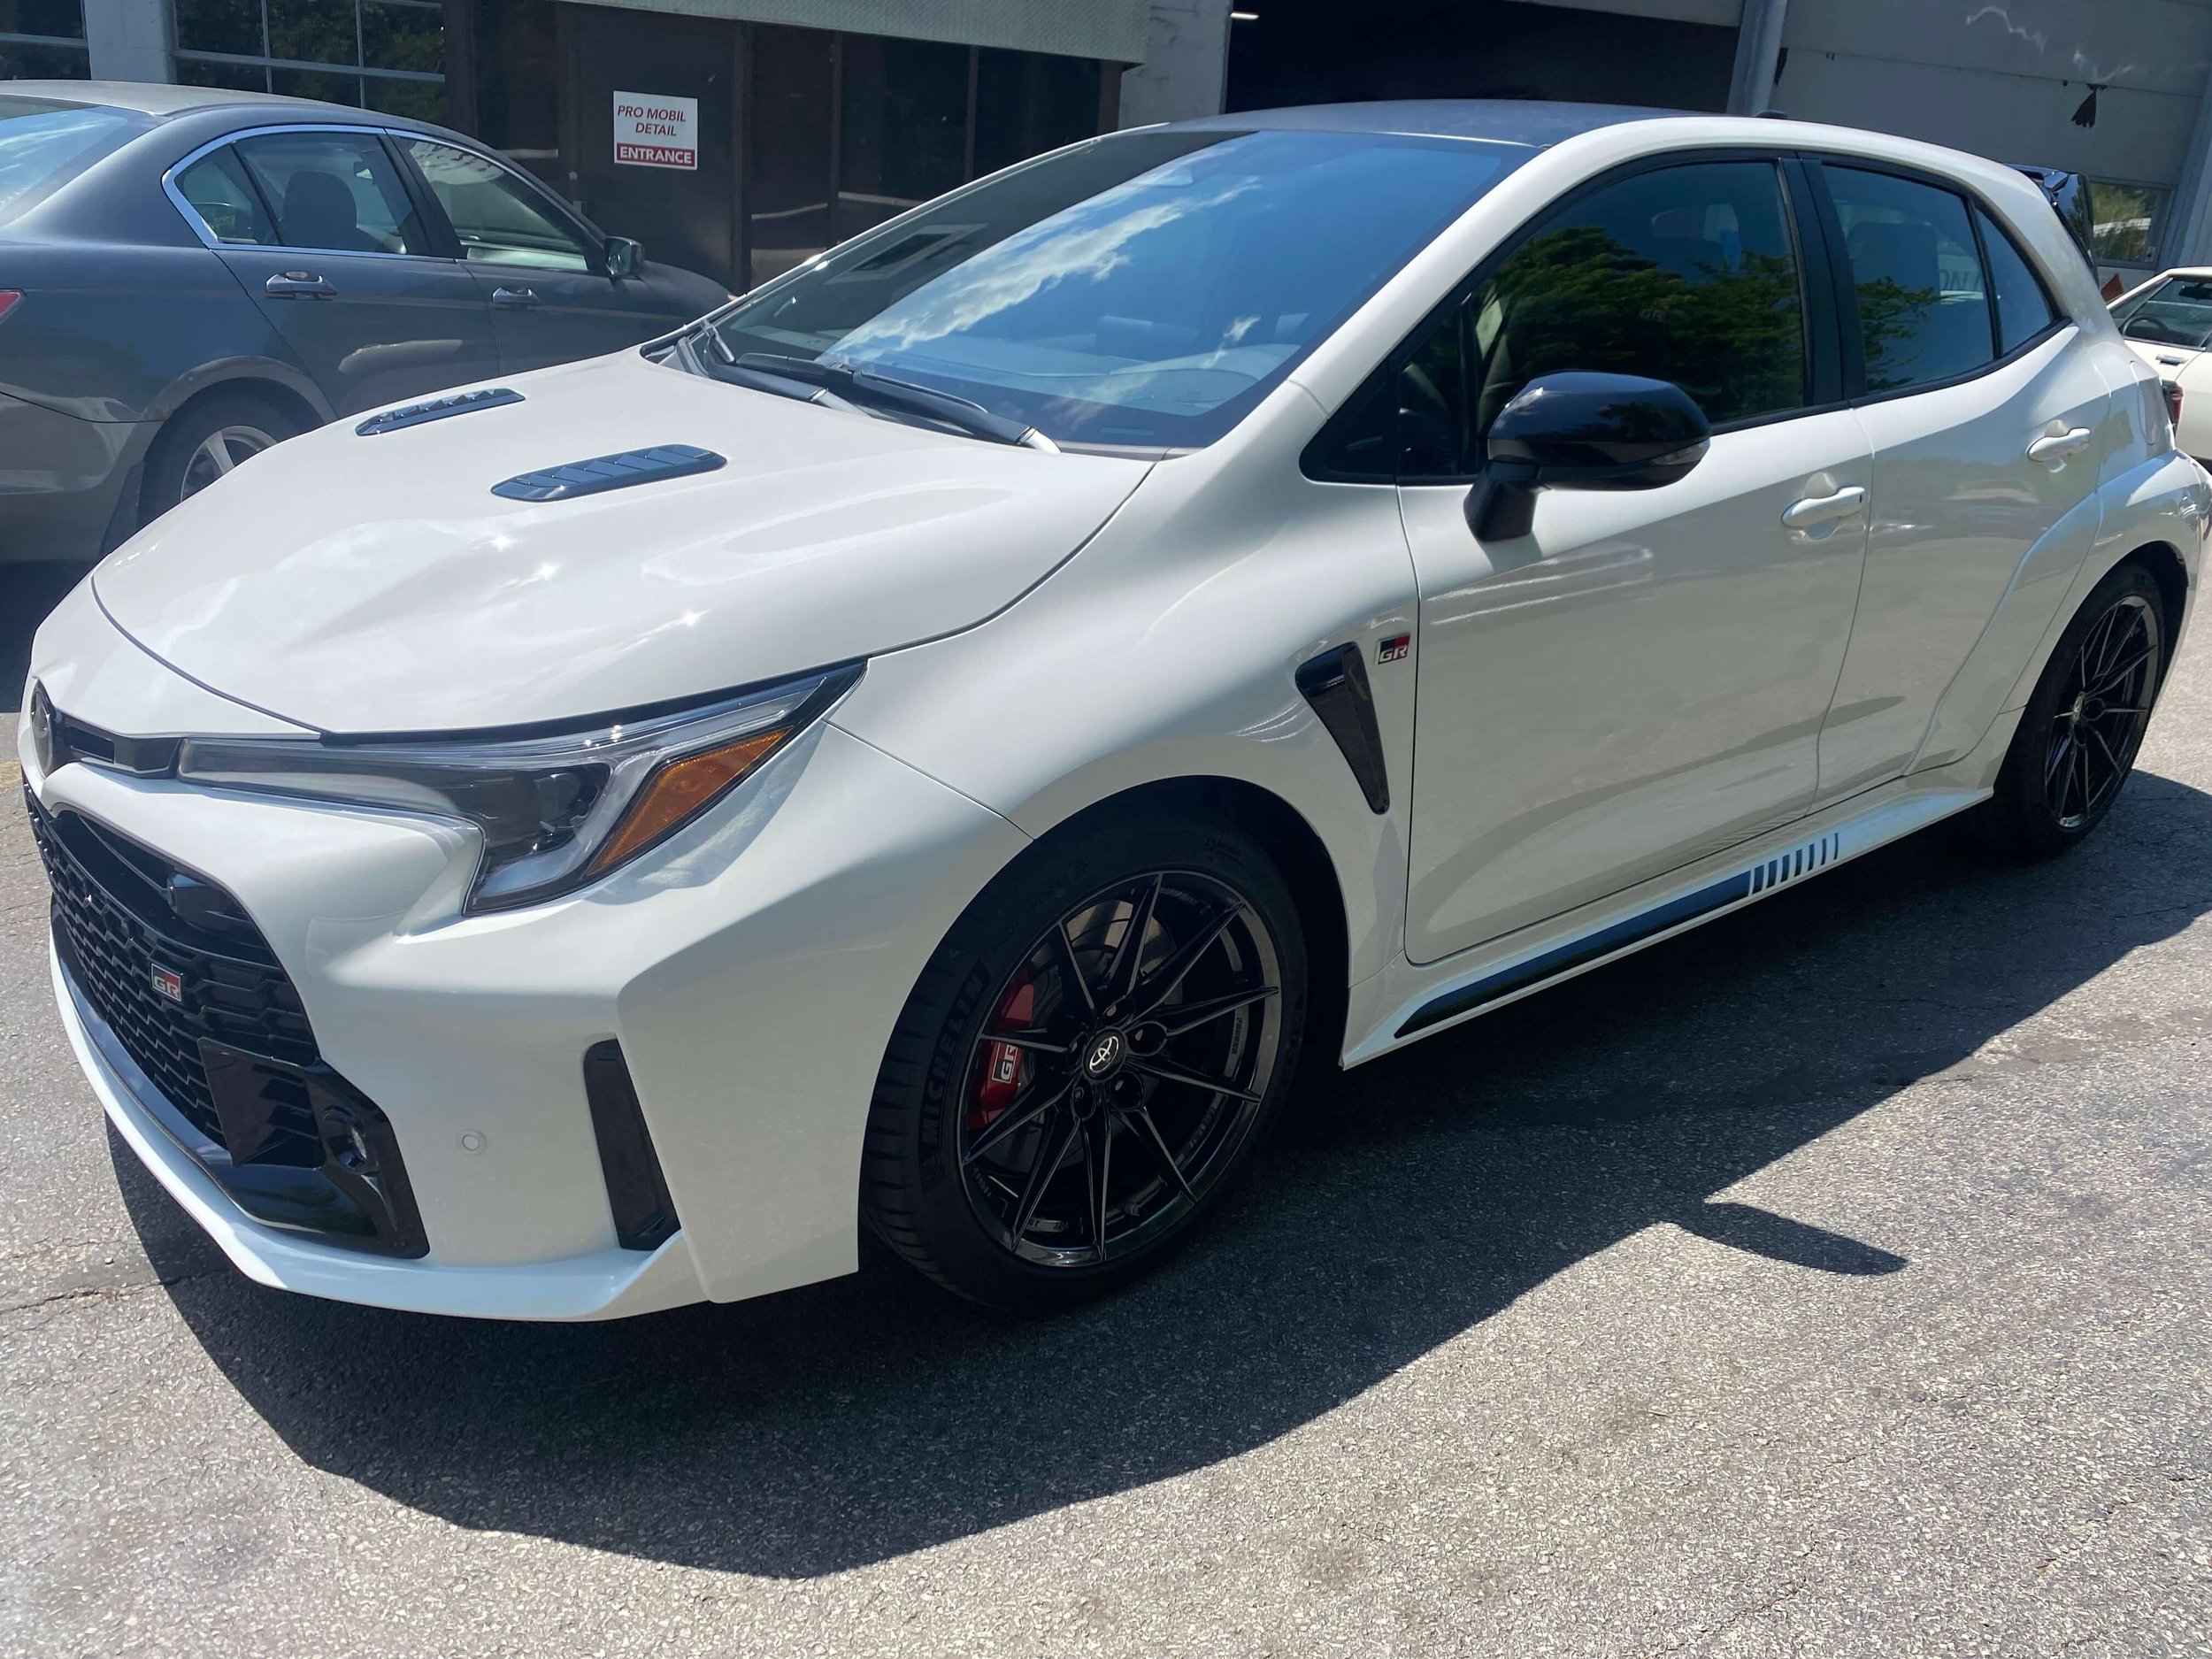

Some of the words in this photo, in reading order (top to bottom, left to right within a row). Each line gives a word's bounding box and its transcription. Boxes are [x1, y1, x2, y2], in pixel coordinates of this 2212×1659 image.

[618, 105, 643, 118] PRO
[647, 108, 686, 122] MOBIL
[635, 122, 677, 136] DETAIL
[619, 146, 692, 164] ENTRANCE
[1379, 645, 1409, 662] GR
[153, 975, 179, 997] GR
[921, 972, 985, 1145] MICHELIN
[1001, 1044, 1017, 1079] GR
